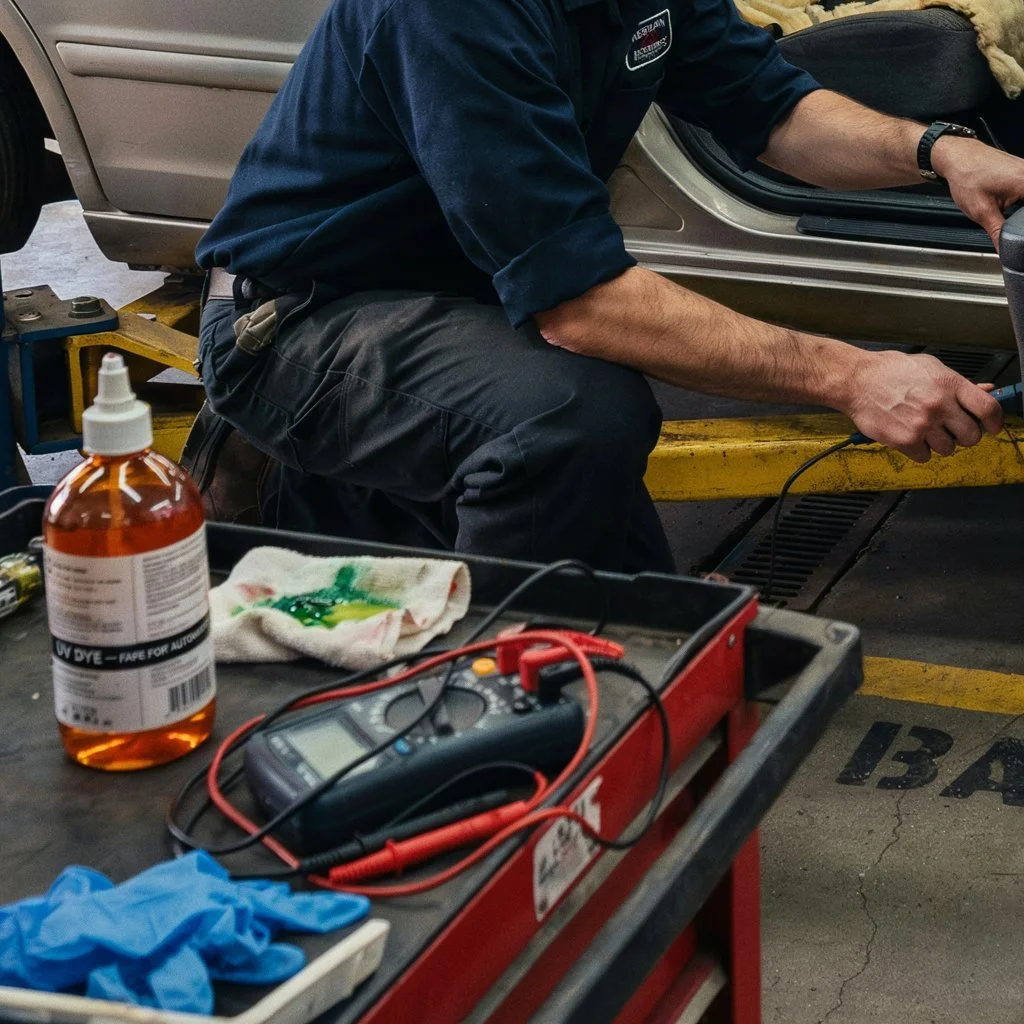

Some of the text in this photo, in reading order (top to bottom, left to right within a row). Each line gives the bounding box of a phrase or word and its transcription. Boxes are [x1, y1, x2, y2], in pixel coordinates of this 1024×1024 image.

[55, 639, 72, 659] UV
[73, 647, 103, 665] DYE
[147, 644, 170, 659] FOR
